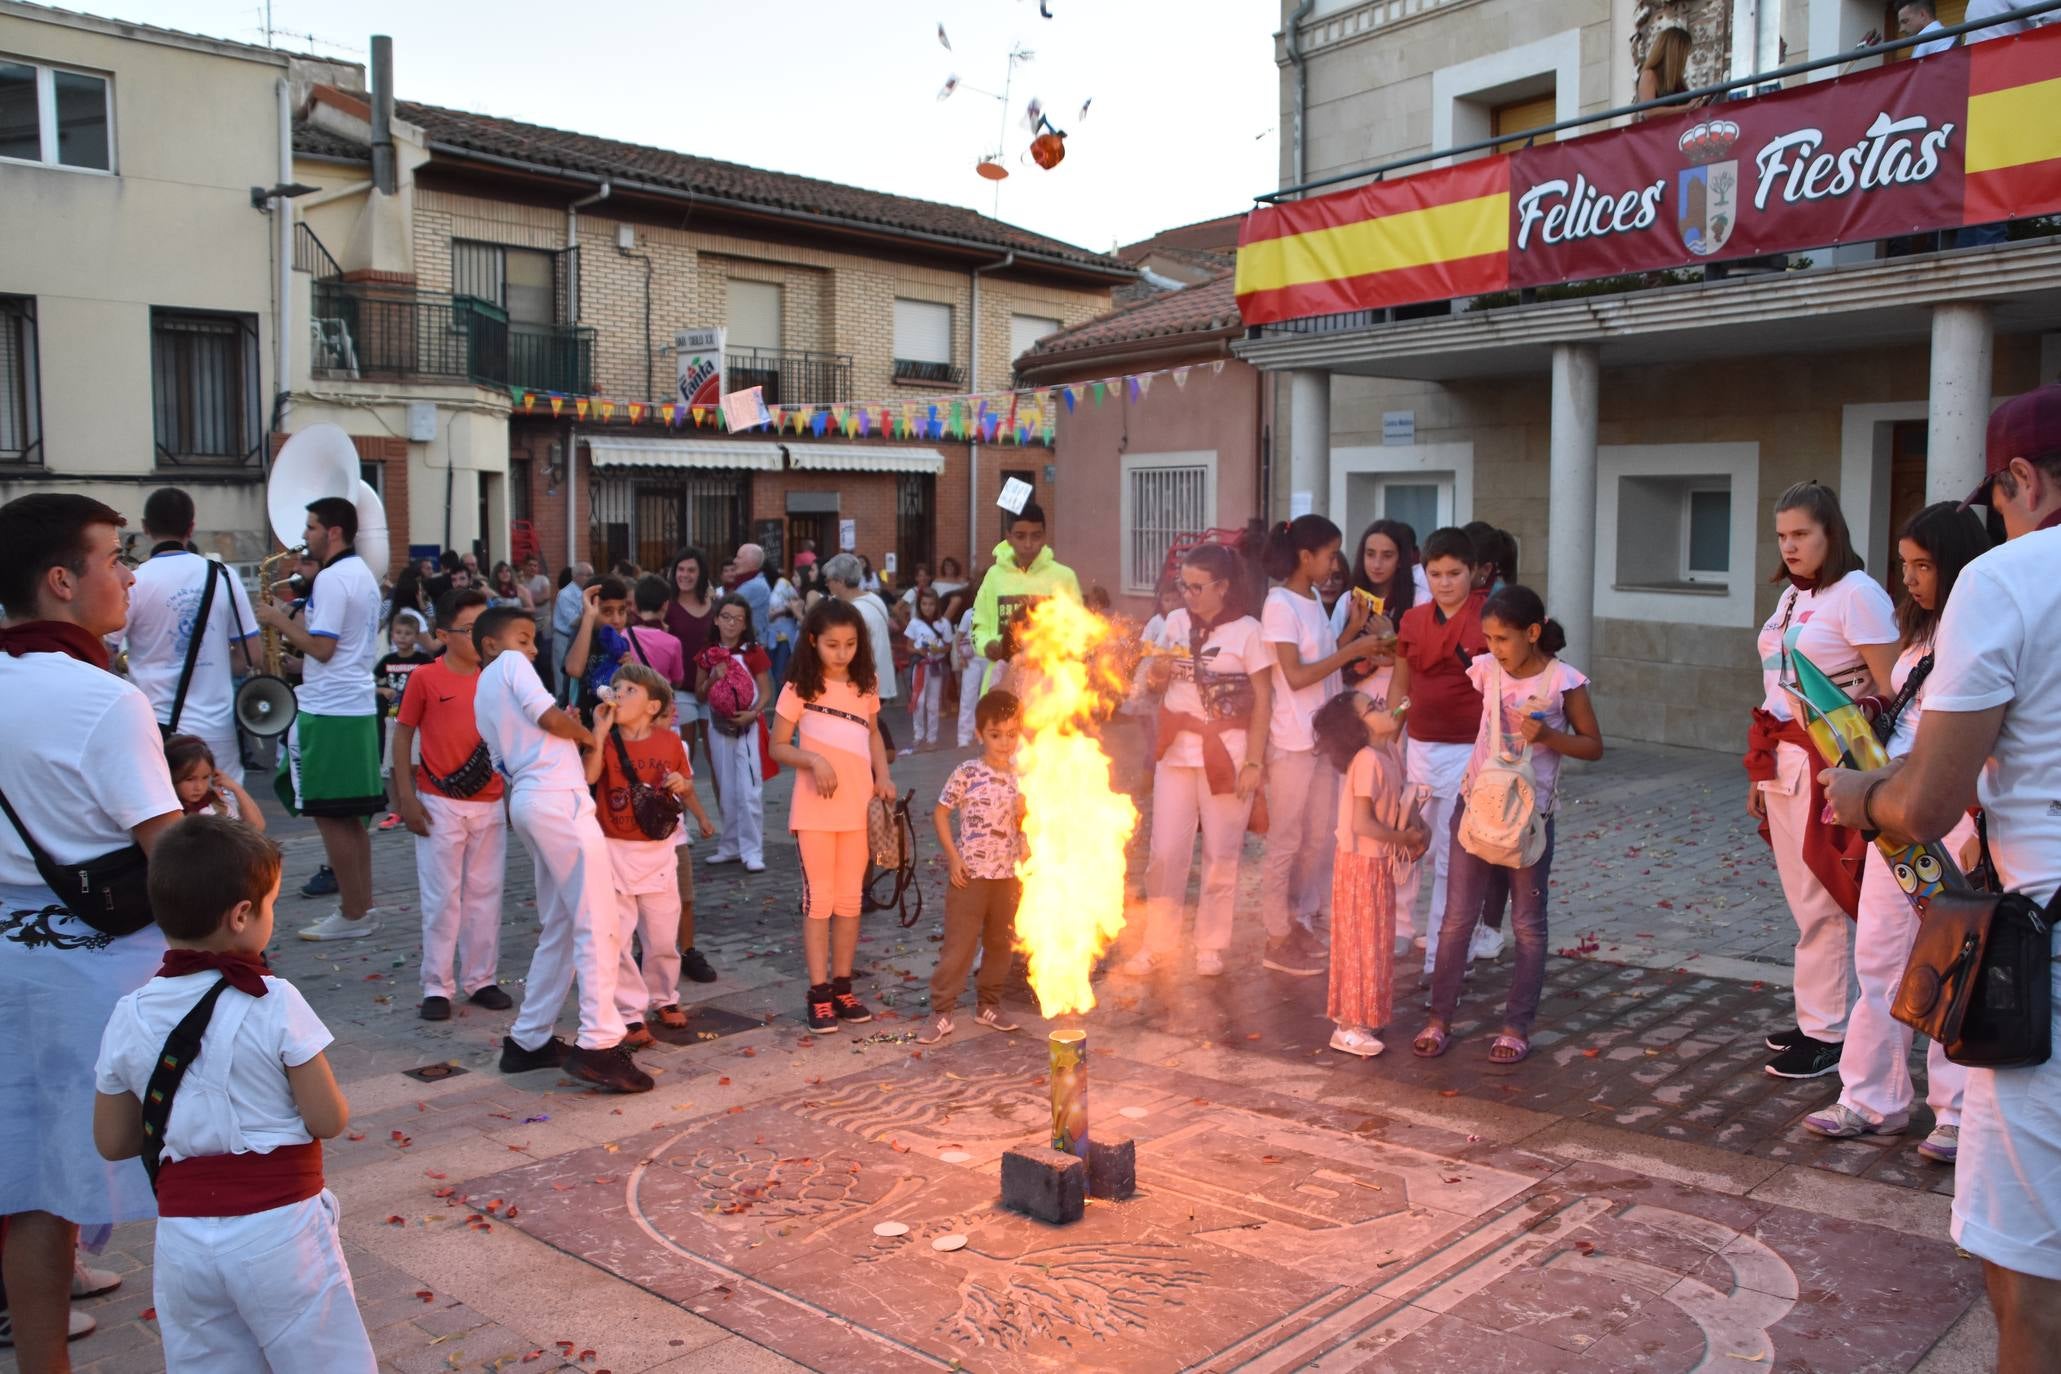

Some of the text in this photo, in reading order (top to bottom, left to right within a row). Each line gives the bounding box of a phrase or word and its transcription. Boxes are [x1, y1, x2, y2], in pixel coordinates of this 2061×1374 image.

[1517, 111, 1956, 251] Felices Fiestas
[679, 359, 715, 401] Fanta
